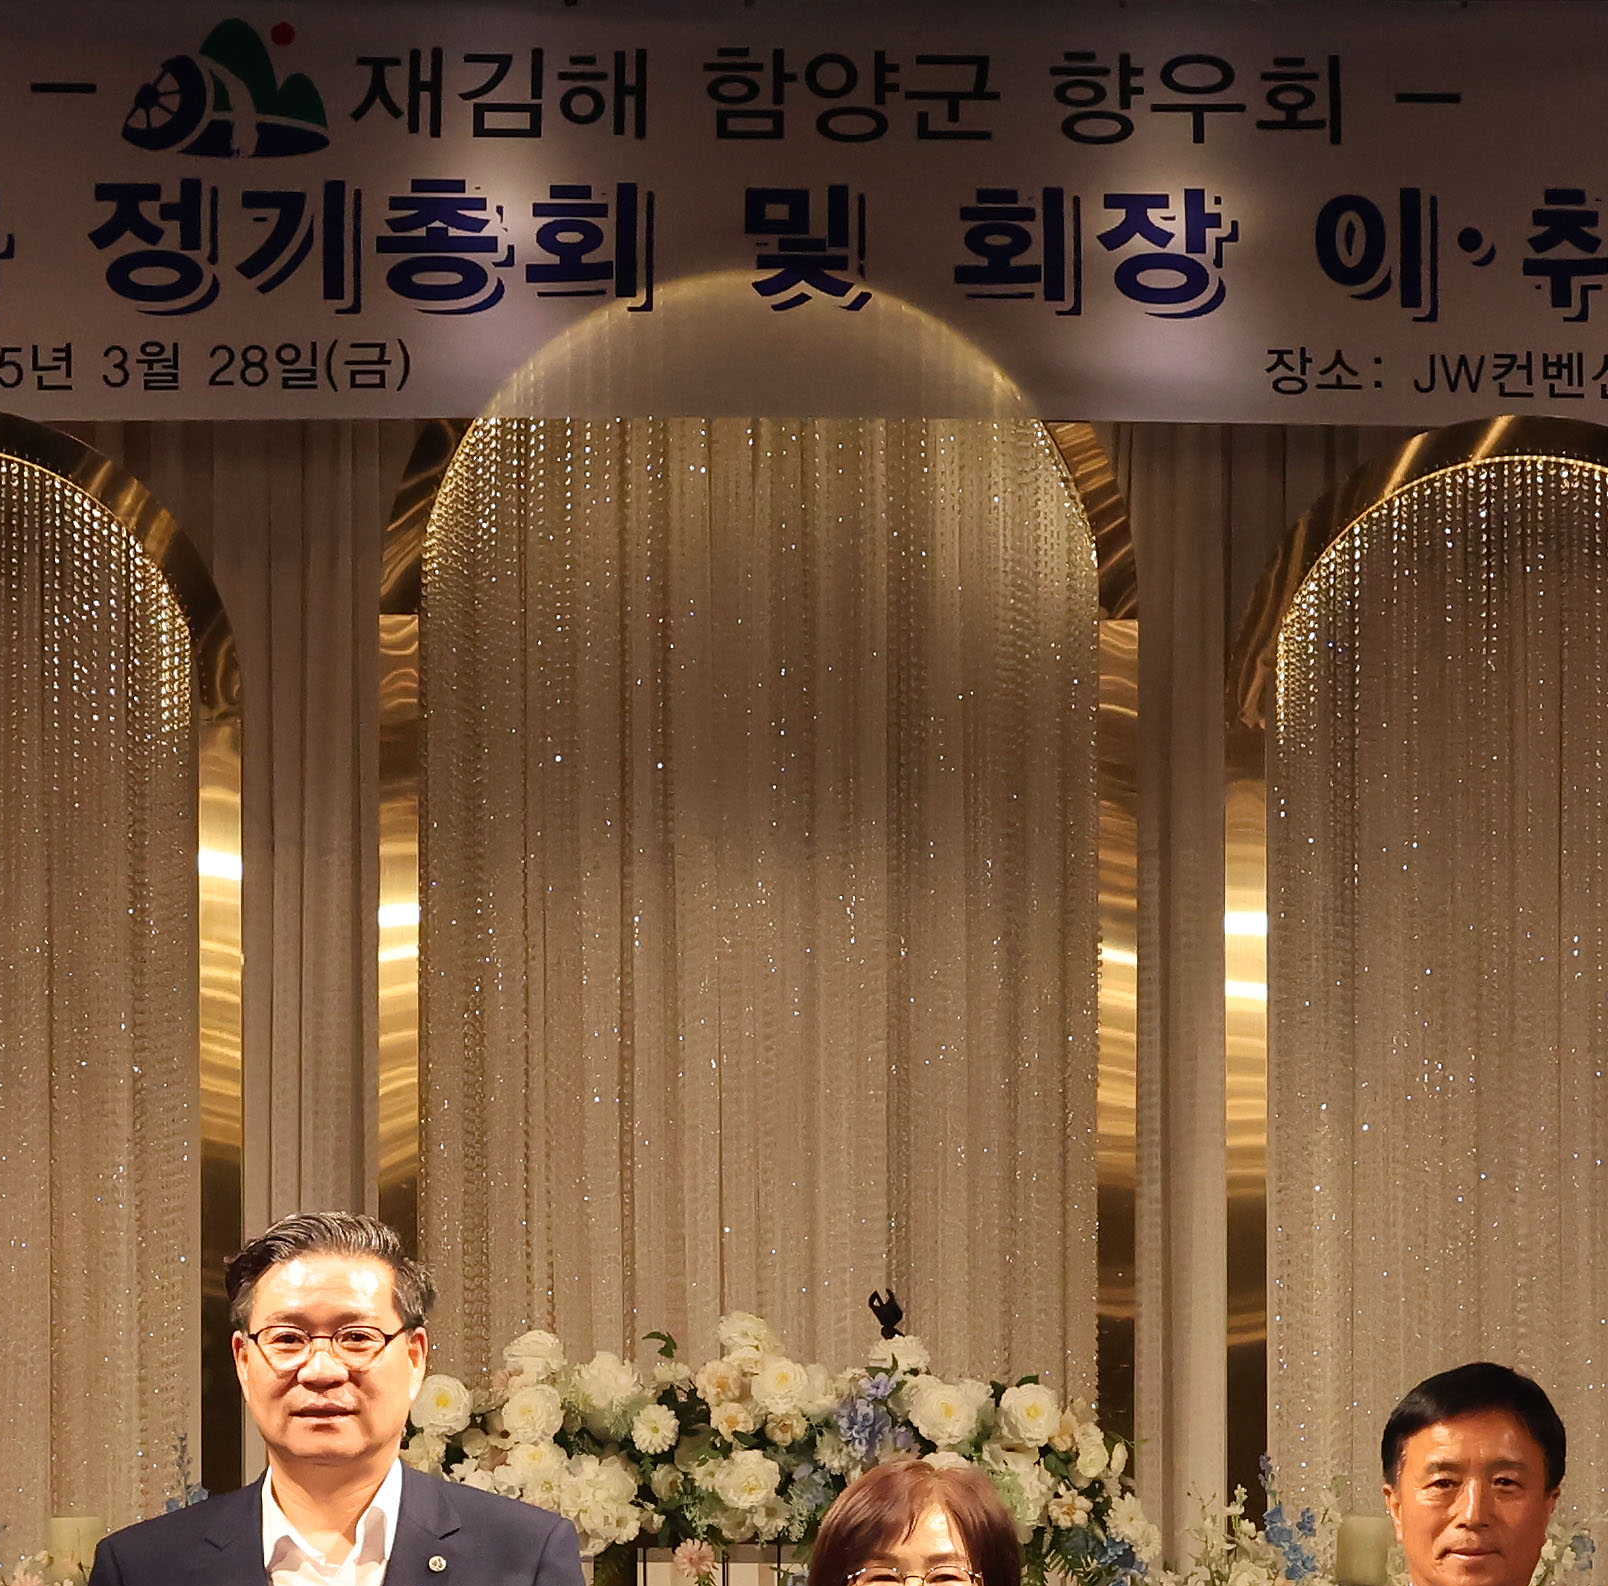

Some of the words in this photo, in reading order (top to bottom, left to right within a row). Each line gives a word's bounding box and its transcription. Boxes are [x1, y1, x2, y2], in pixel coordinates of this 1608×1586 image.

[349, 46, 648, 142] 재김해
[703, 43, 1002, 142] 함양군
[1048, 49, 1344, 144] 향우회
[89, 176, 654, 316] 정기총회
[743, 185, 872, 312] 및
[953, 186, 1238, 319] 회장
[101, 344, 187, 392] 3월
[208, 338, 411, 392] 28일(금)
[1263, 344, 1383, 397] 장소:
